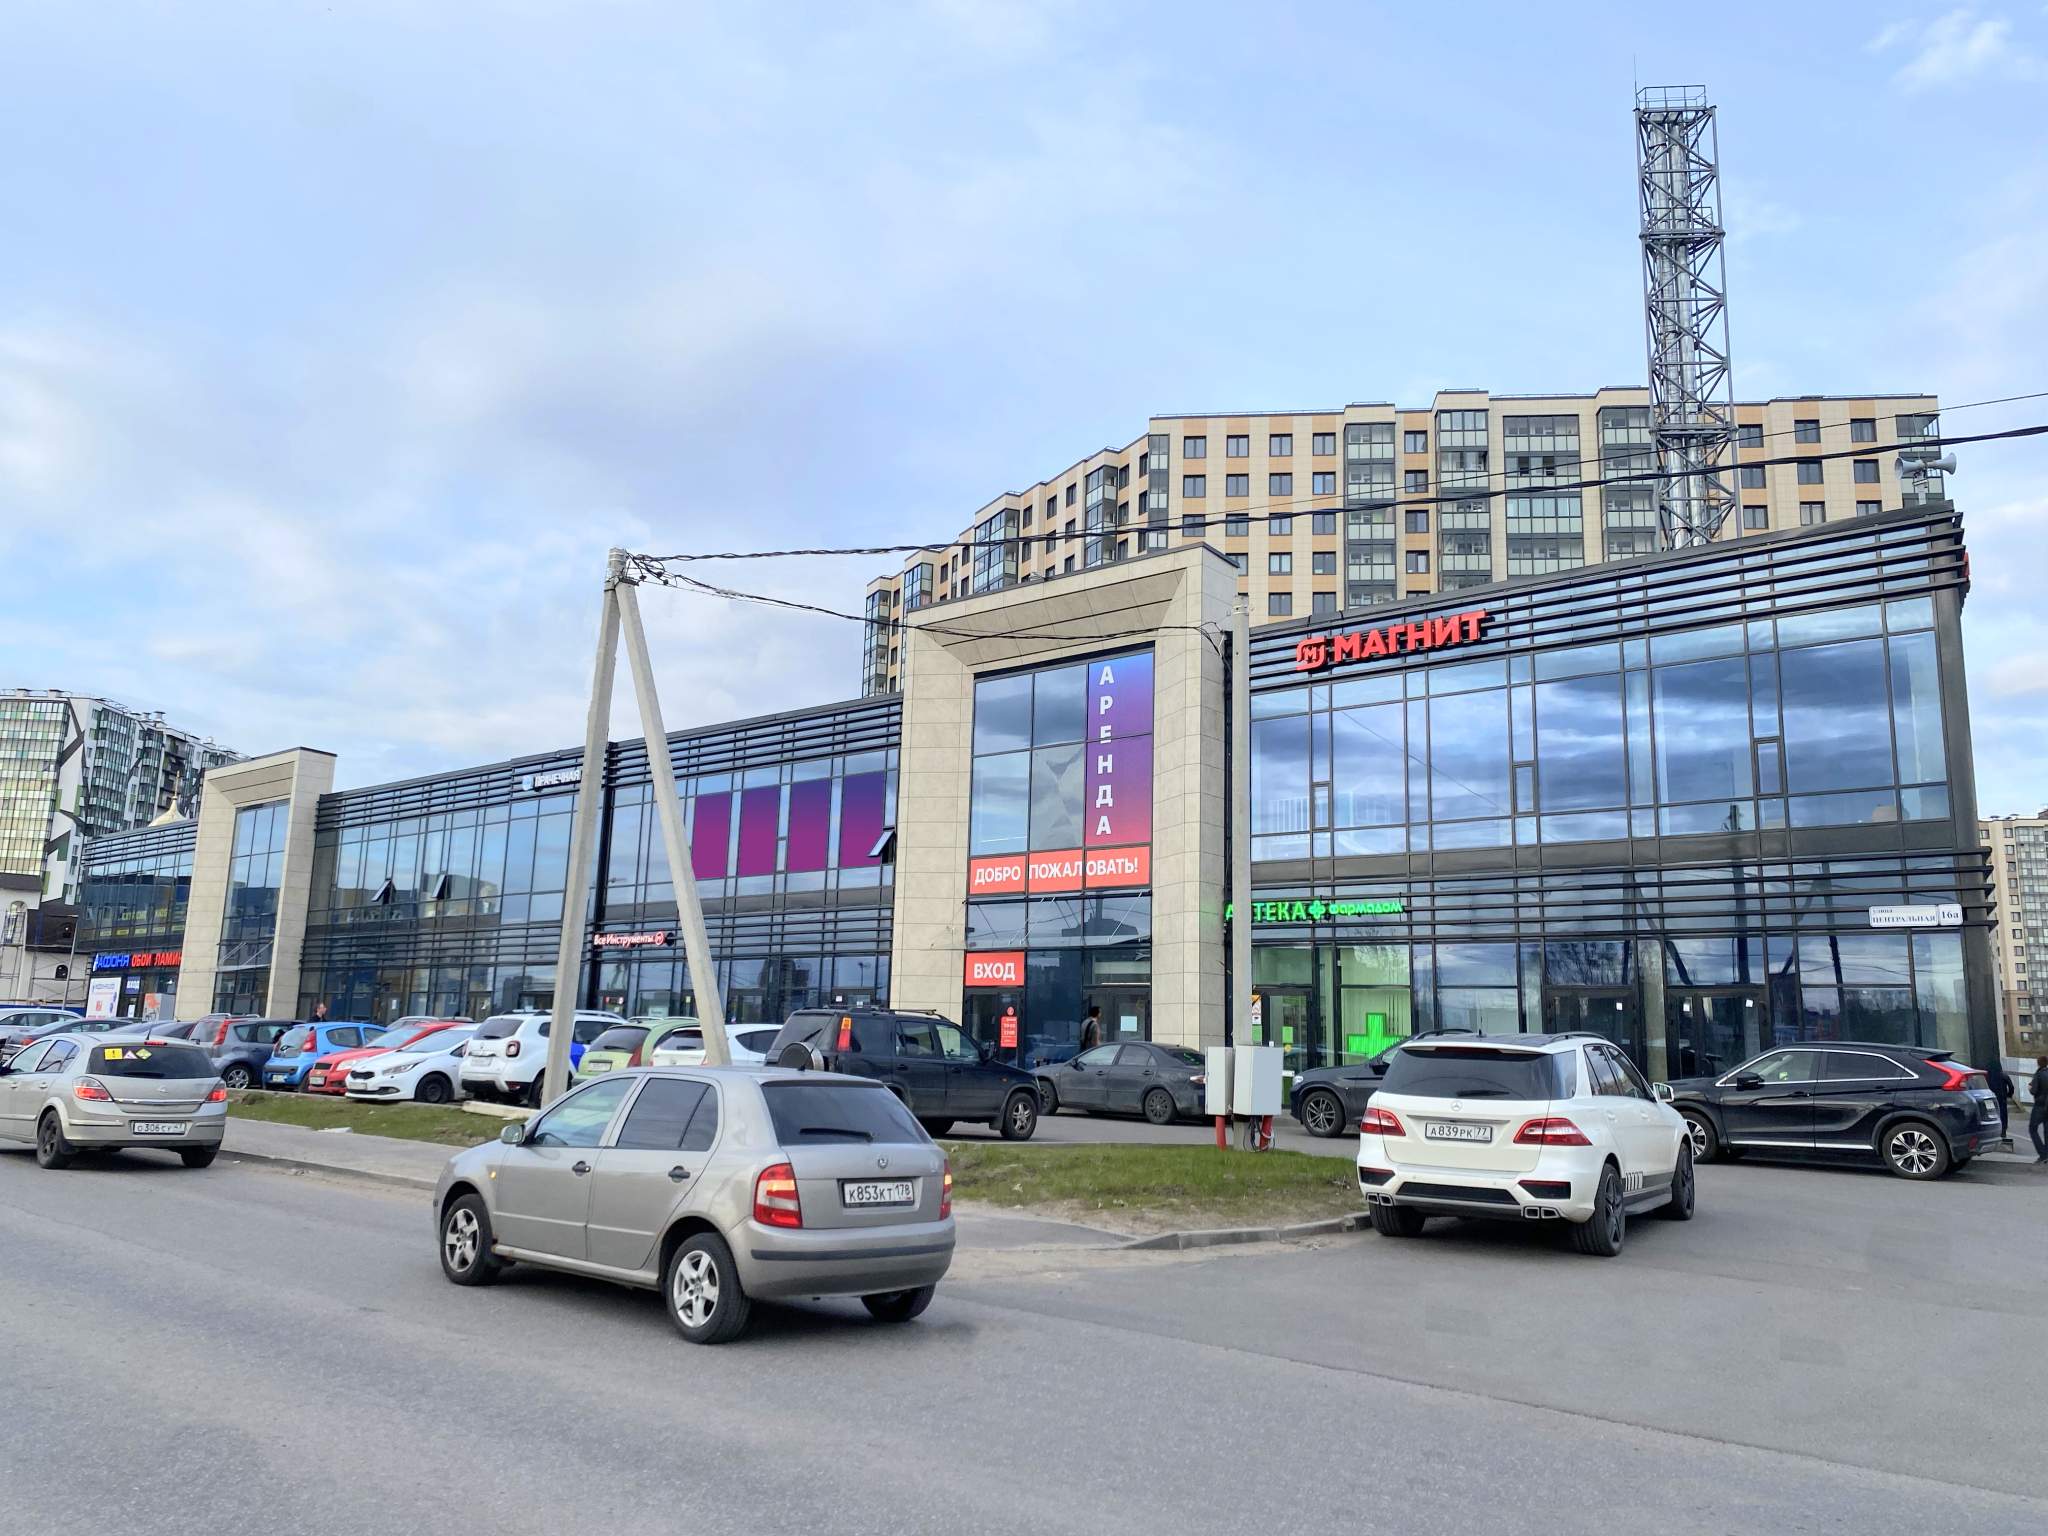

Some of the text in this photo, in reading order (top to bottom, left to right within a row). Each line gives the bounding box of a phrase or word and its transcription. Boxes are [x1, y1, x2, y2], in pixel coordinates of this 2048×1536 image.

[1334, 609, 1488, 664] МАГНИТ
[1096, 666, 1115, 835] АРЕНДА
[974, 857, 1138, 885] ДОБРО ПОЖАЛОВАТЬ!
[973, 962, 1016, 981] ВХОД
